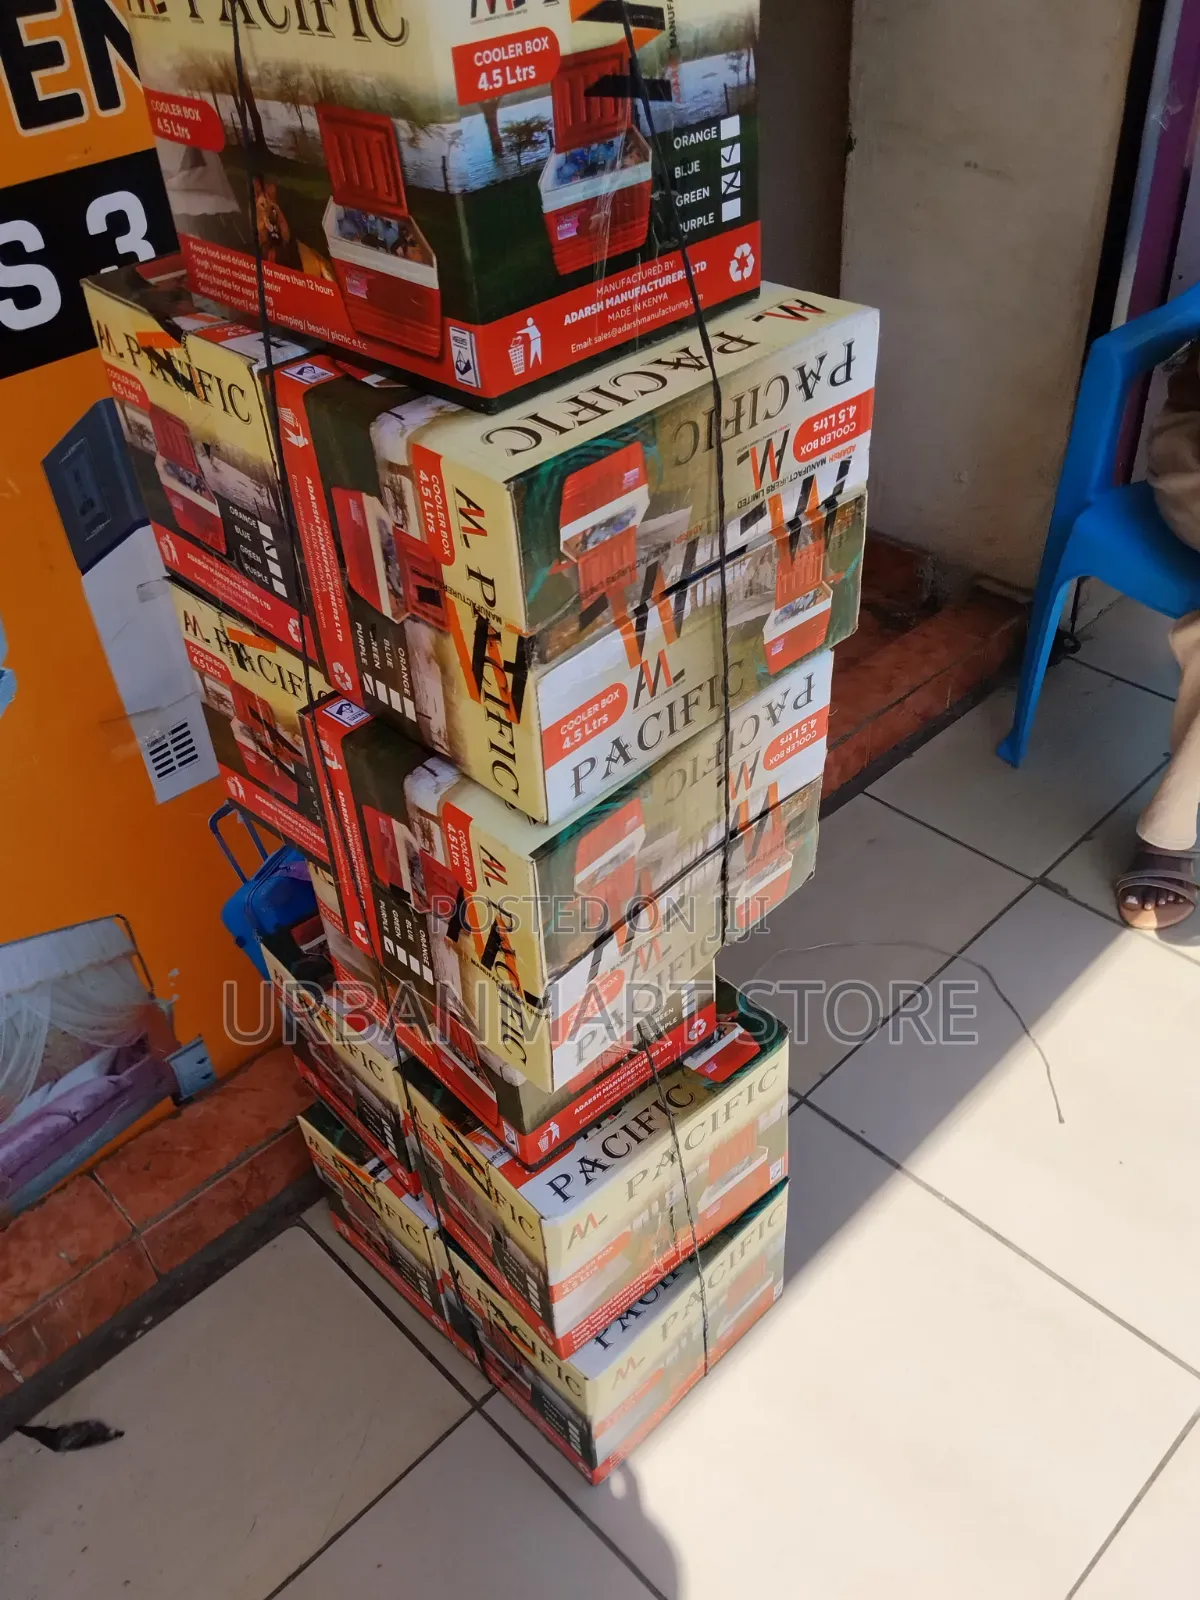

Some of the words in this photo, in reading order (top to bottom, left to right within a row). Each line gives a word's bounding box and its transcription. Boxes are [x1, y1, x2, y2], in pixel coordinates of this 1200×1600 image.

[473, 44, 523, 66] COOLER
[525, 36, 550, 54] BOX
[477, 68, 503, 91] 4.5
[506, 65, 536, 86] Ltrs
[151, 99, 183, 117] COOLER
[182, 106, 202, 121] BOX
[157, 117, 171, 134] 4.5
[170, 120, 191, 139] Ltrs
[673, 127, 717, 149] ORANGE
[674, 161, 700, 179] BLUE
[675, 187, 710, 206] GREEN
[231, 256, 249, 270] drinks
[263, 265, 274, 278] for
[274, 271, 291, 284] more
[291, 274, 306, 288] than
[306, 279, 315, 291] 12
[315, 283, 335, 297] hours
[597, 265, 662, 297] MANUFACTURED
[662, 259, 676, 275] BY:
[564, 303, 604, 326] ADARSH
[690, 260, 707, 276] LTD
[607, 308, 633, 323] MADE
[632, 304, 641, 314] IN
[642, 292, 668, 309] KENYA
[330, 330, 351, 346] picnic
[571, 336, 593, 354] Email:
[593, 292, 704, 345] sales@adarshmanufacturing.cm
[480, 331, 760, 457] PACIFIC
[673, 338, 855, 467] PACIFIC
[813, 413, 836, 432] Ltrs
[838, 405, 856, 425] 4.5
[800, 437, 819, 456] BOX
[820, 421, 856, 446] COOLER
[828, 443, 857, 463] ADARSH
[419, 469, 431, 497] 4.5
[737, 489, 765, 509] LIMITED
[229, 505, 258, 529] ORANGE
[424, 500, 436, 534] Ltrs
[431, 475, 446, 527] COOLER
[441, 531, 452, 557] BOX
[234, 525, 252, 541] BLUE
[239, 544, 262, 564] GREEN
[306, 476, 320, 524] ADARSH
[315, 525, 340, 615] MANUFACTURERS
[334, 616, 344, 642] LTD
[309, 522, 319, 547] MADE
[317, 560, 327, 593] KENYA
[321, 519, 342, 598] MANUFACTURED
[244, 563, 269, 585] PURPLE
[355, 622, 368, 666] PURPLE
[383, 639, 393, 669] BLUE
[398, 647, 411, 697] ORANGE
[560, 701, 600, 735] COOLER
[598, 689, 620, 709] BOX
[562, 729, 583, 750] 4.5
[584, 712, 609, 735] Ltrs
[570, 659, 746, 801] PACIFIC
[664, 672, 814, 805] PACIFIC
[779, 728, 799, 747] Ltrs
[798, 718, 817, 737] 4.5
[768, 750, 787, 766] BOX
[785, 730, 817, 757] COOLER
[458, 829, 470, 868] COOLER
[463, 868, 474, 888] BOX
[379, 900, 389, 933] PURPLE
[392, 909, 402, 939] GREEN
[405, 919, 414, 942] BLUE
[419, 929, 430, 967] ORANGE
[574, 1092, 601, 1115] ADARSH
[602, 1049, 659, 1093] MANUFACTURRS
[660, 1040, 673, 1053] LTD
[595, 1055, 643, 1091] MANUFACTURED
[604, 1082, 622, 1099] MADE
[620, 1079, 628, 1087] IN
[626, 1066, 646, 1084] KENYA
[546, 1084, 695, 1204] PACIFIC
[626, 1063, 779, 1201] PACIFIC
[660, 1202, 784, 1341] PACIFIC
